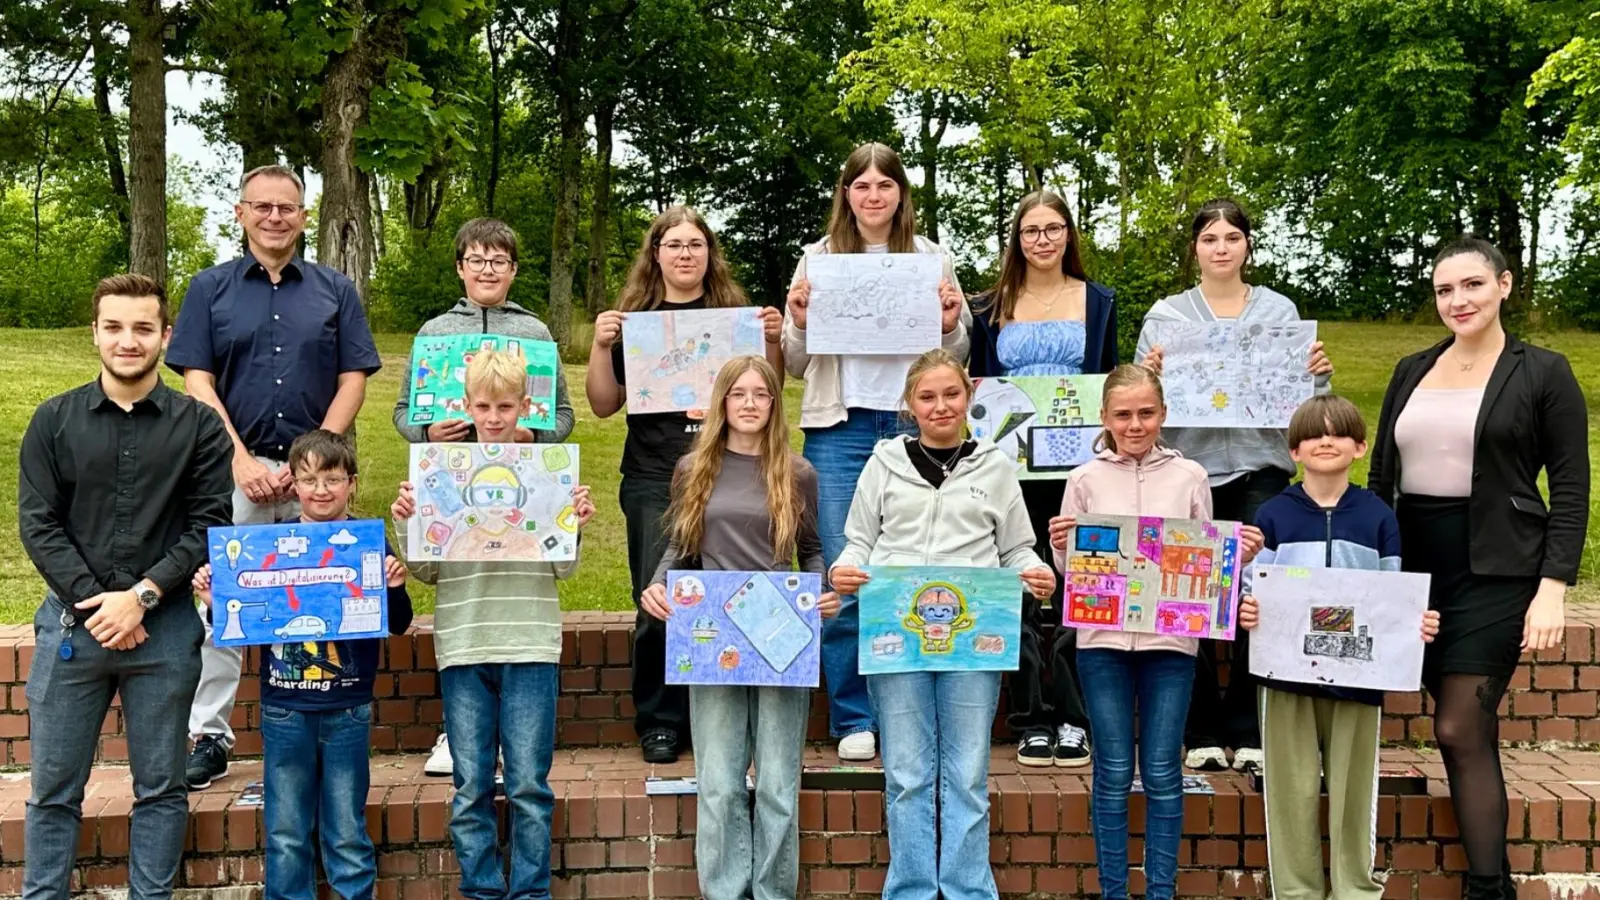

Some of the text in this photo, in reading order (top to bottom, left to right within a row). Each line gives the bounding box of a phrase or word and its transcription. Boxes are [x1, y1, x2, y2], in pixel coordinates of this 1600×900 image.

[486, 490, 504, 500] VR
[241, 573, 263, 587] Was
[267, 573, 277, 585] ist
[269, 676, 331, 692] Boarding
